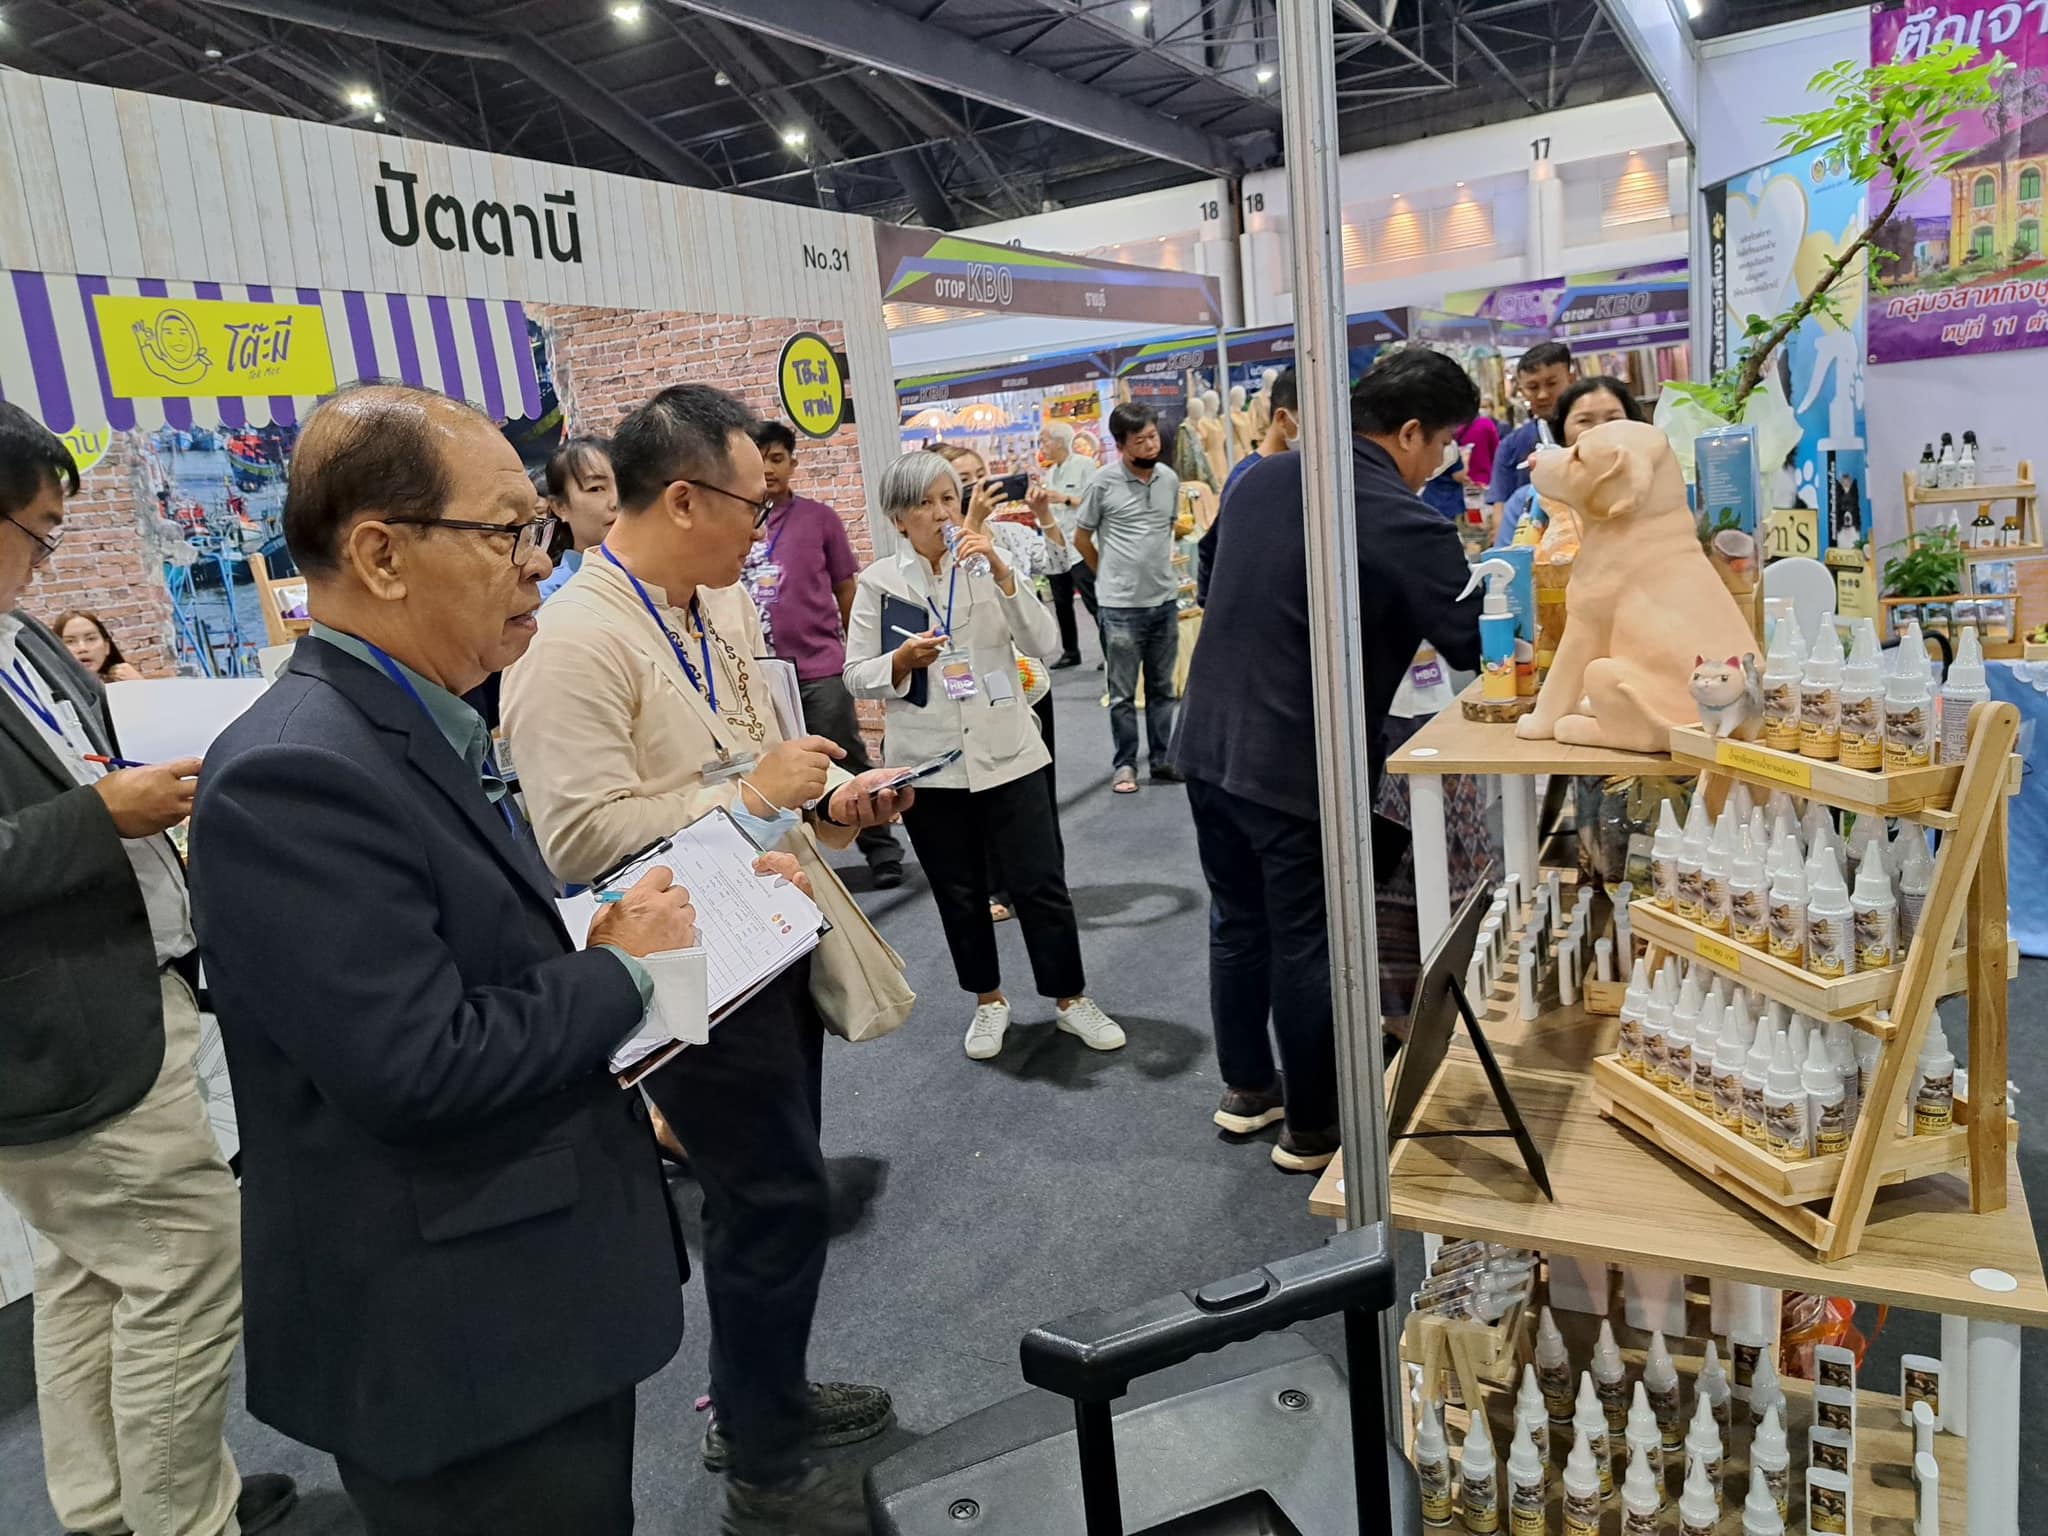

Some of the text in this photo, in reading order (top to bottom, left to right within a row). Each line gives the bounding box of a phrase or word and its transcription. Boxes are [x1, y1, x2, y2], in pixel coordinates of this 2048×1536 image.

[1530, 136, 1550, 160] 17
[375, 160, 583, 263] ปัตตานี
[1200, 201, 1219, 221] 18
[1245, 193, 1264, 213] 18
[803, 244, 850, 272] No.31
[935, 262, 1013, 305] OTOP KBO
[1562, 290, 1649, 322] OTOP KBO
[1941, 313, 1986, 345] หมู่ที่
[1993, 315, 2018, 336] 11
[1144, 350, 1204, 373] OTOP KBO
[919, 384, 949, 402] KBO
